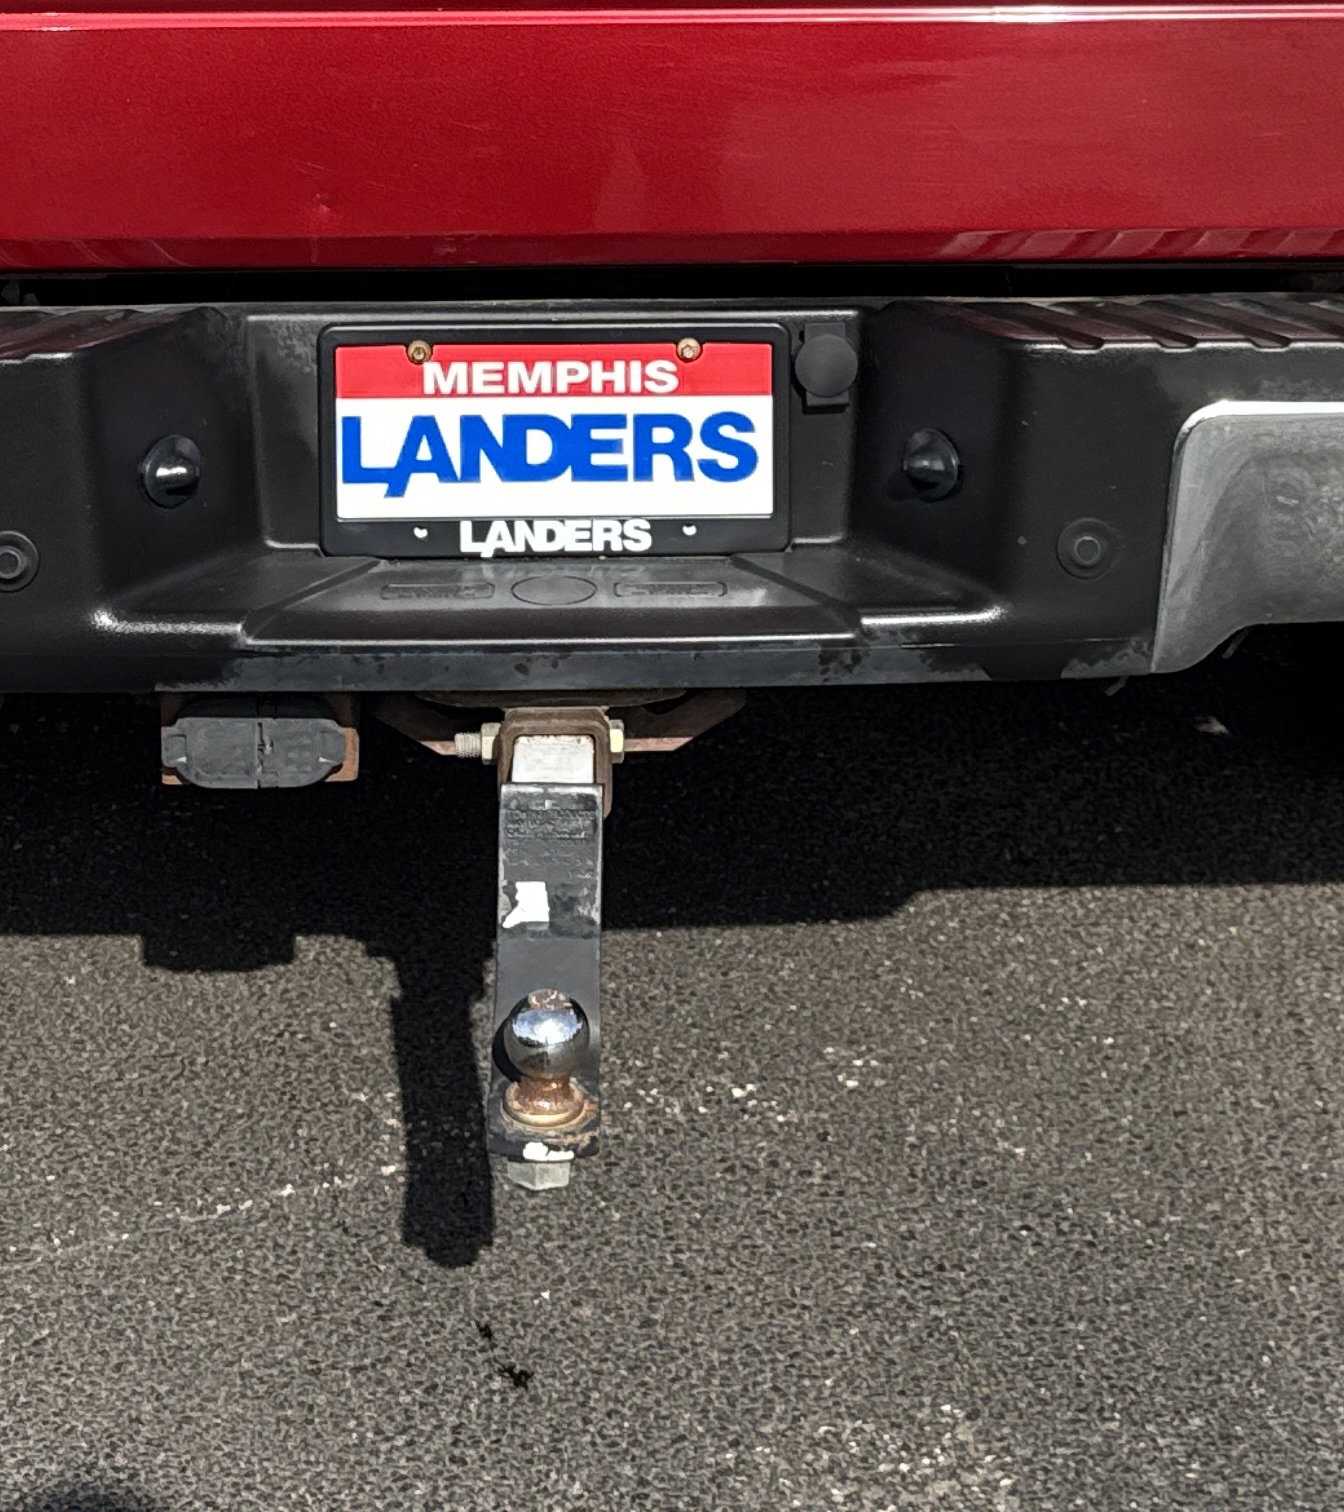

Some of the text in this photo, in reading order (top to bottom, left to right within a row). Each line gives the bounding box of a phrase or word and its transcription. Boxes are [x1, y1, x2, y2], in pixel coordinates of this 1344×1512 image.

[422, 360, 679, 395] MEMPHIS
[341, 411, 759, 498] LANDERS
[459, 519, 652, 558] LANDERS
